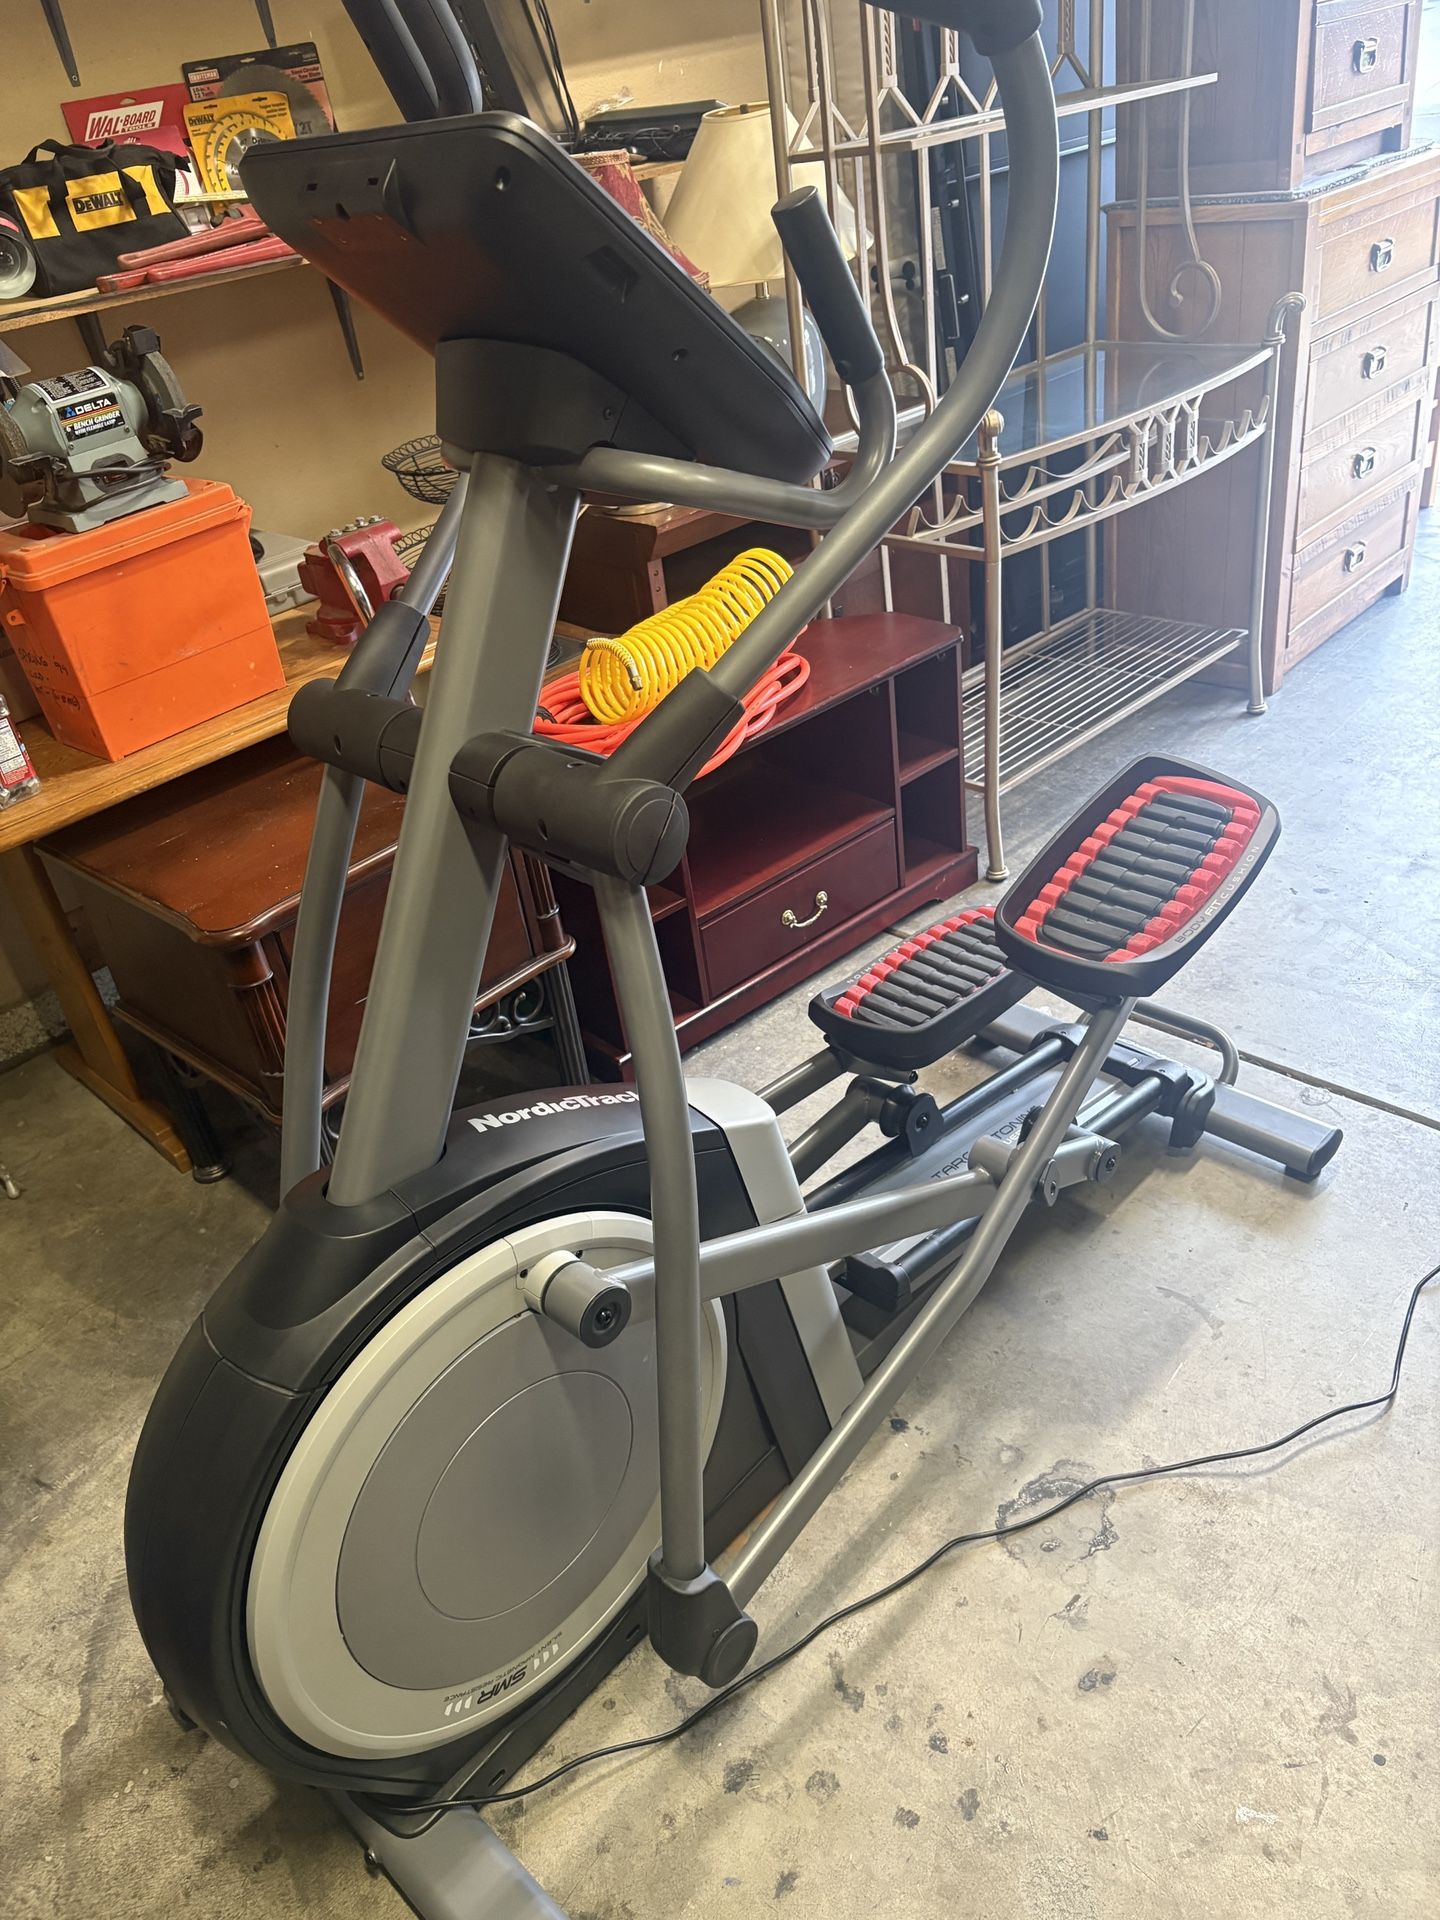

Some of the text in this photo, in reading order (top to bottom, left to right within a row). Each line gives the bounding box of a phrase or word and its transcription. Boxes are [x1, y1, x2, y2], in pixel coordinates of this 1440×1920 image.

[188, 113, 215, 127] DEWALT
[73, 190, 124, 213] DEWALT
[75, 399, 111, 415] DELTA
[74, 419, 93, 430] BENCH
[94, 410, 120, 424] GRINDER
[1175, 846, 1260, 944] BODY FIT CUSHION
[443, 1631, 562, 1702] SILENT MAGNETIC RESISTANCE
[477, 1665, 528, 1705] SMR
